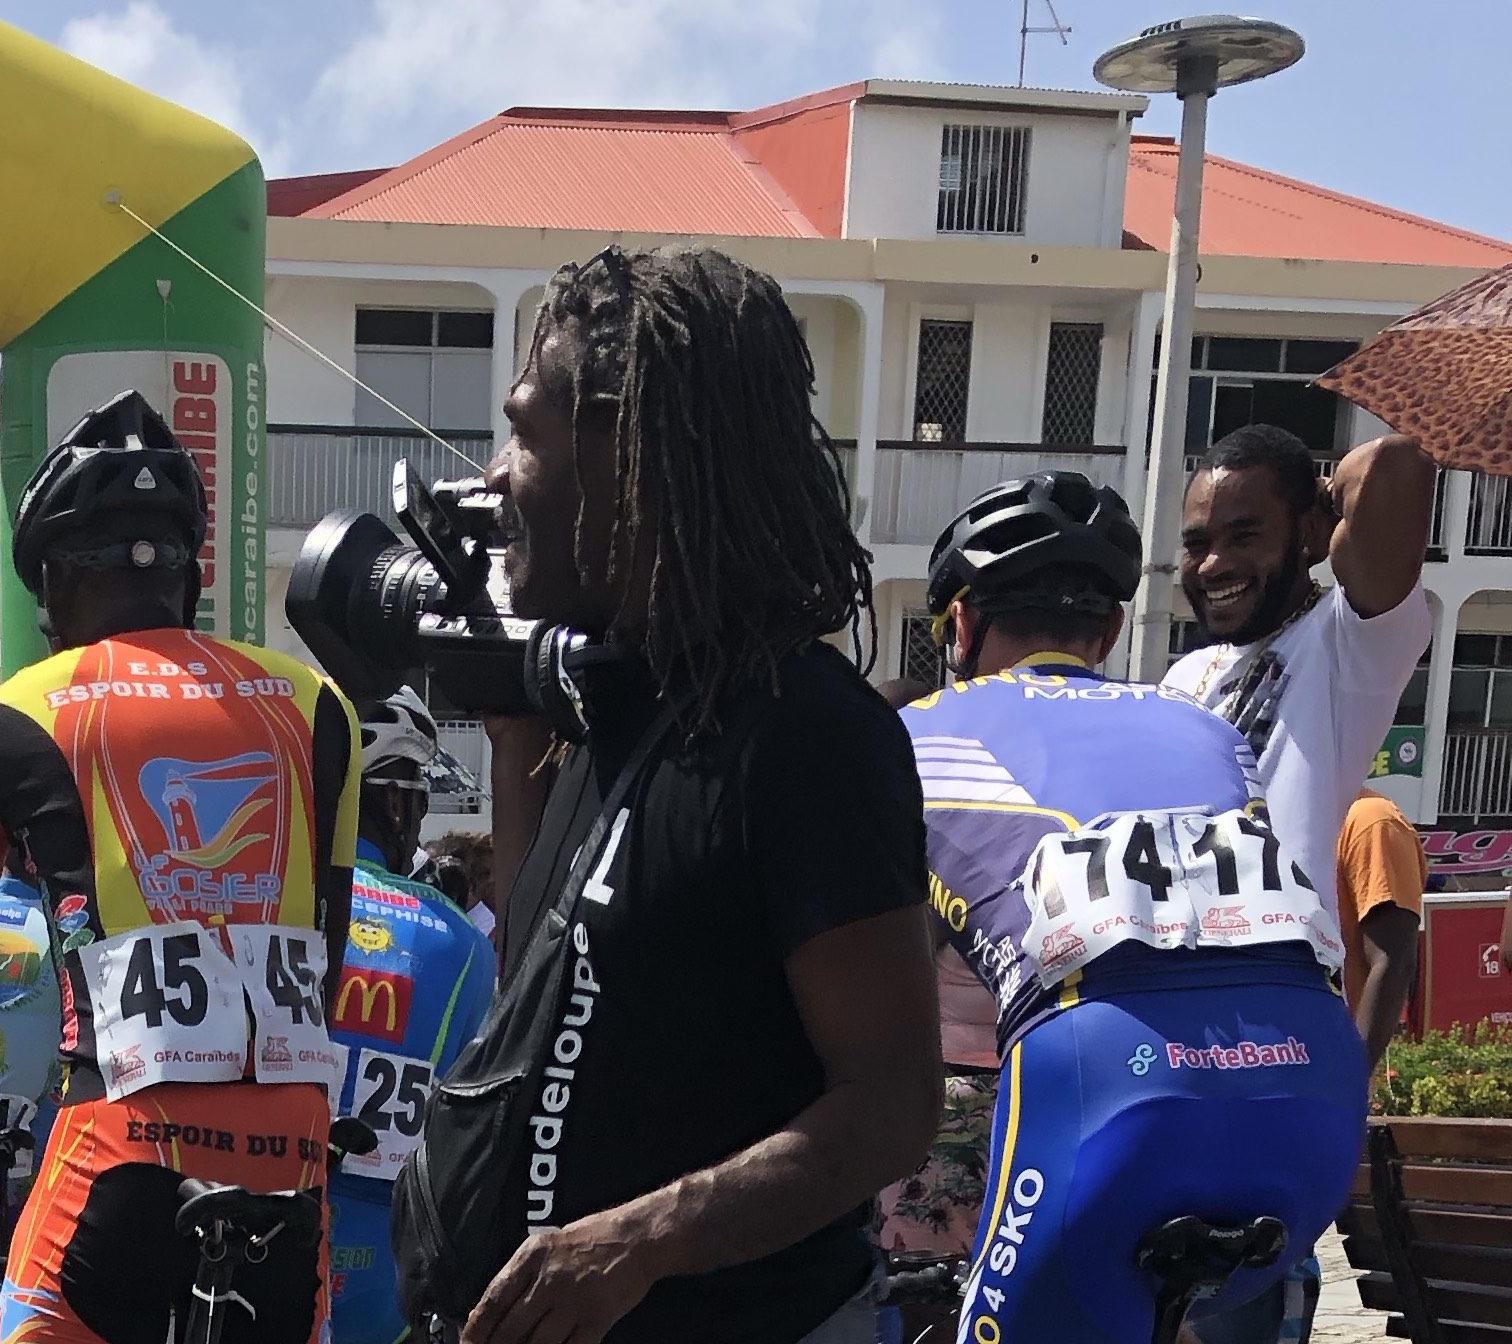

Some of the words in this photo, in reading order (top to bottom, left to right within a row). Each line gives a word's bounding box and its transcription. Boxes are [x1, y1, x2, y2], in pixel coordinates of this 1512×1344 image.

[127, 661, 208, 678] E.D.S
[44, 680, 172, 711] ESPOIR
[179, 682, 226, 701] DU
[235, 676, 297, 699] SUD
[140, 867, 281, 904] GOSIER
[1092, 915, 1126, 936] GFA
[1261, 913, 1296, 926] GFA
[120, 933, 208, 1029] 45
[154, 1051, 182, 1063] GFA
[1165, 1035, 1311, 1070] ForteBank
[526, 921, 602, 1234] uadeloupe
[357, 1056, 432, 1138] 25
[126, 1120, 236, 1153] ESPOIR
[245, 1135, 287, 1156] DU
[989, 1167, 1045, 1278] SKO
[981, 1284, 1006, 1314] 4
